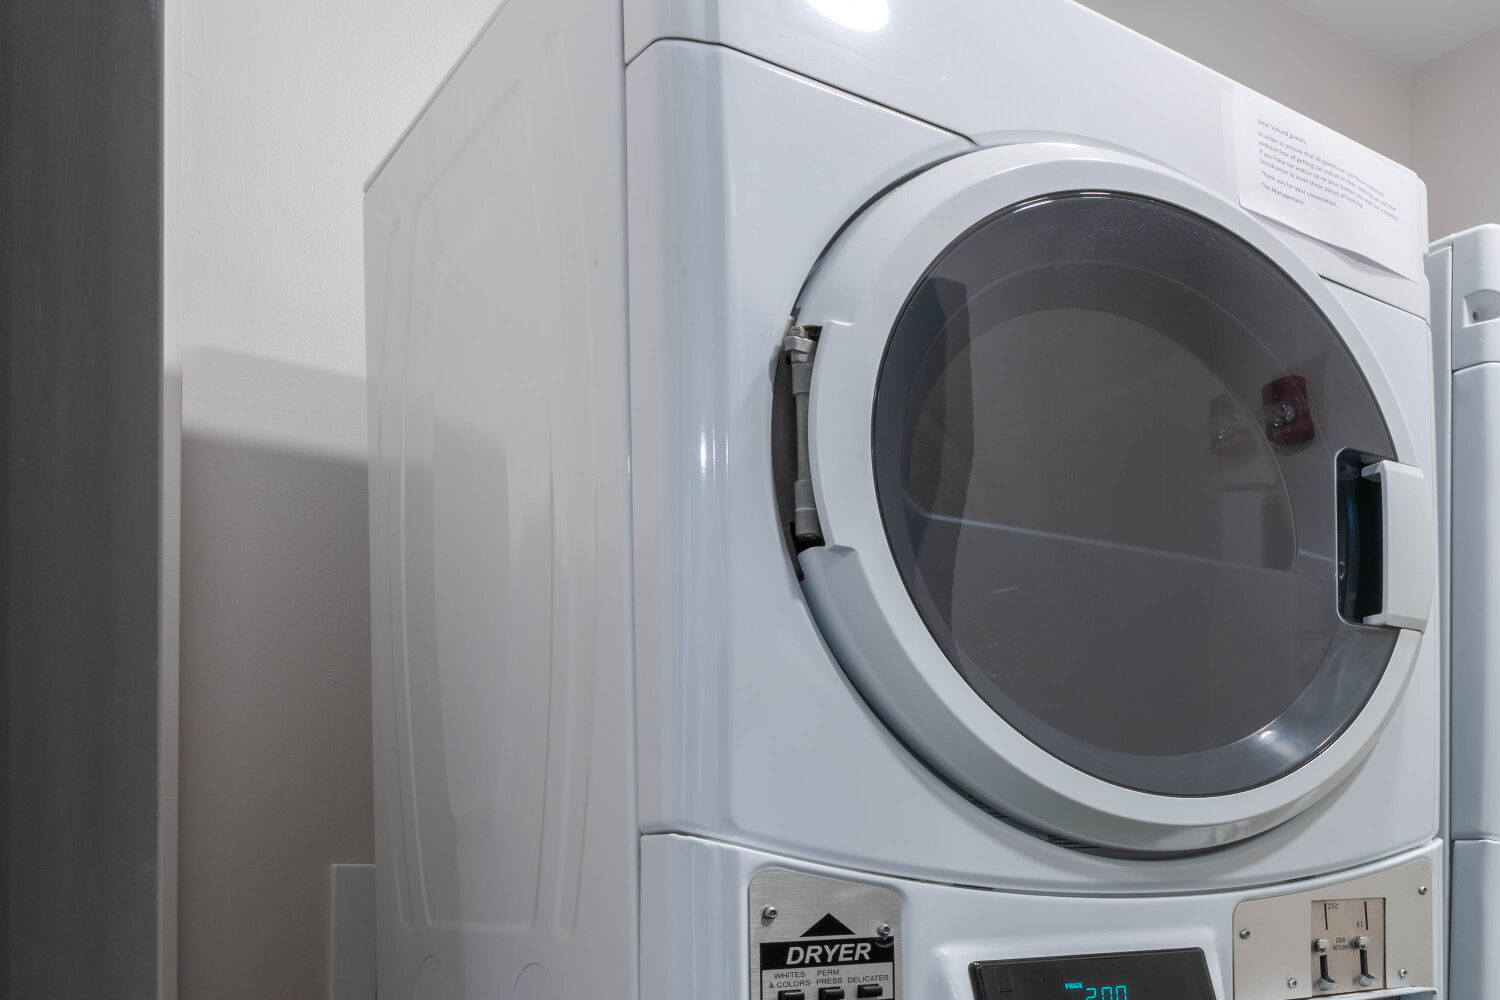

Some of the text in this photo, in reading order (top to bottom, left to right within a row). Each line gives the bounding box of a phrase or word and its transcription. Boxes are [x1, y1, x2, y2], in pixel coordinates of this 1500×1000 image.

[785, 942, 872, 965] DRYER
[774, 971, 806, 979] WHITES
[816, 969, 840, 977] PERM
[776, 979, 811, 988] COLORS
[816, 977, 843, 985] PRESS
[847, 974, 889, 984] DELICATES
[1065, 981, 1083, 991] PRICE
